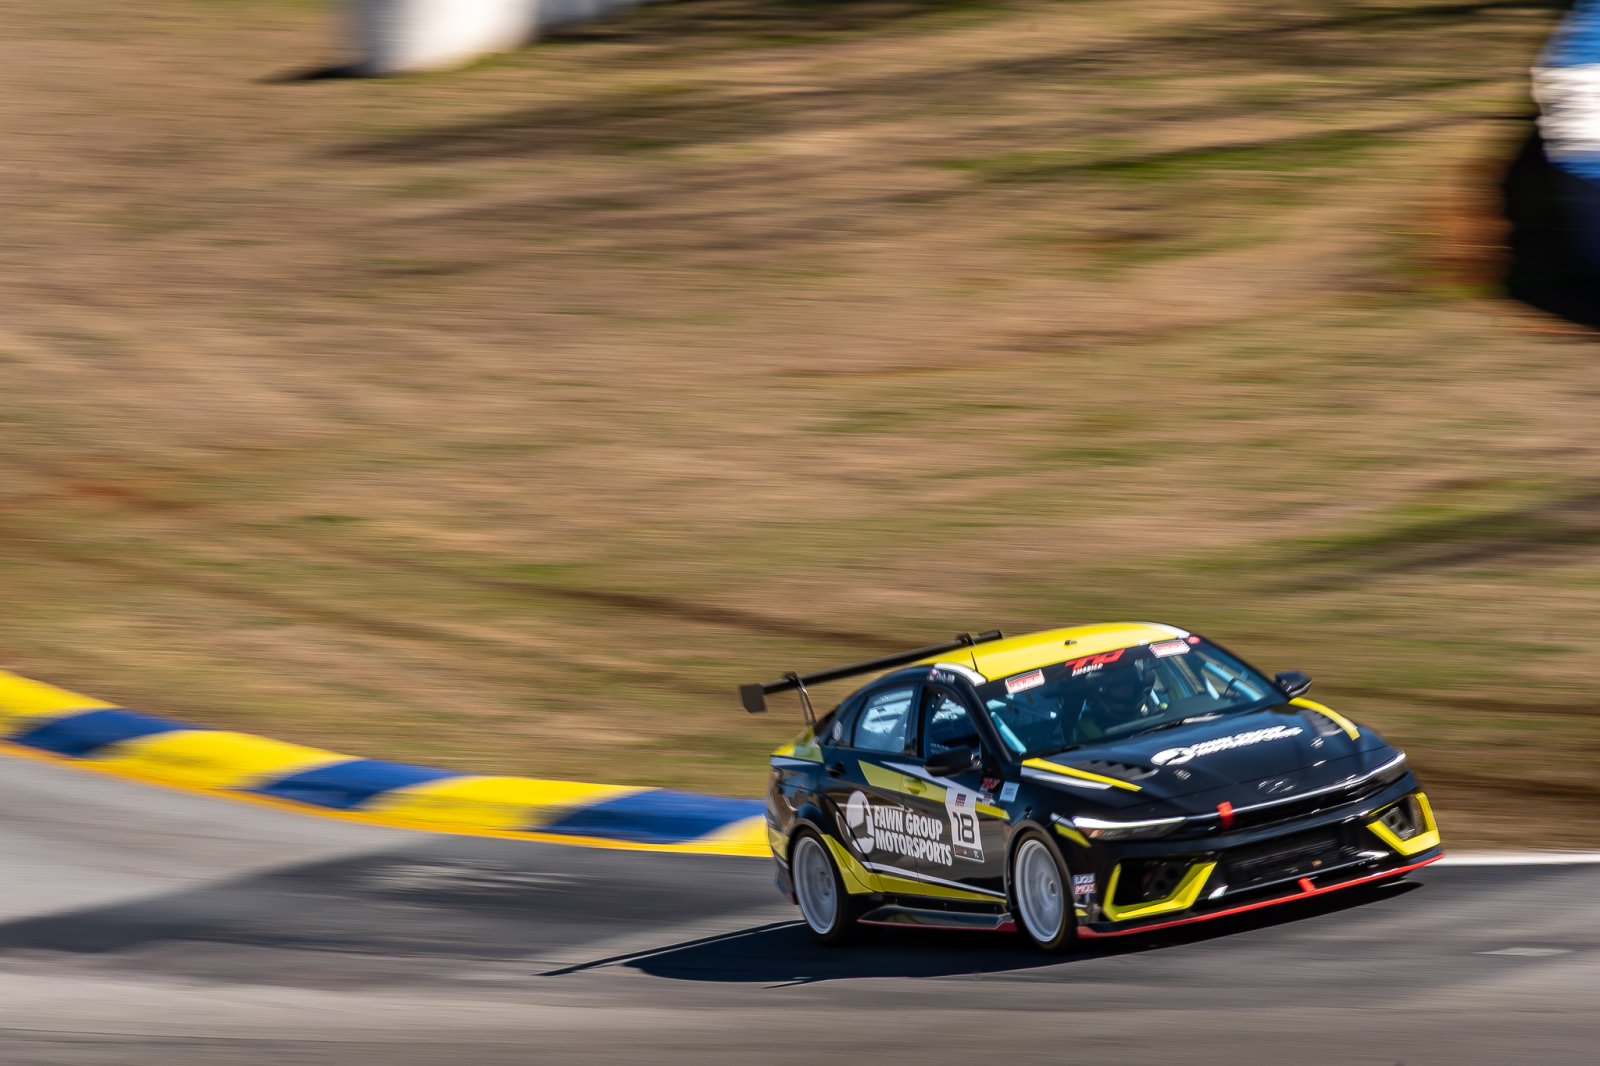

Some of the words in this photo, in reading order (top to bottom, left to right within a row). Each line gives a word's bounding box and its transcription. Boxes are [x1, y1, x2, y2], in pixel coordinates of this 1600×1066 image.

[874, 805, 904, 833] FAWN
[905, 812, 943, 841] GROUP
[952, 811, 975, 844] 18
[875, 829, 953, 867] MOTORSPORTS
